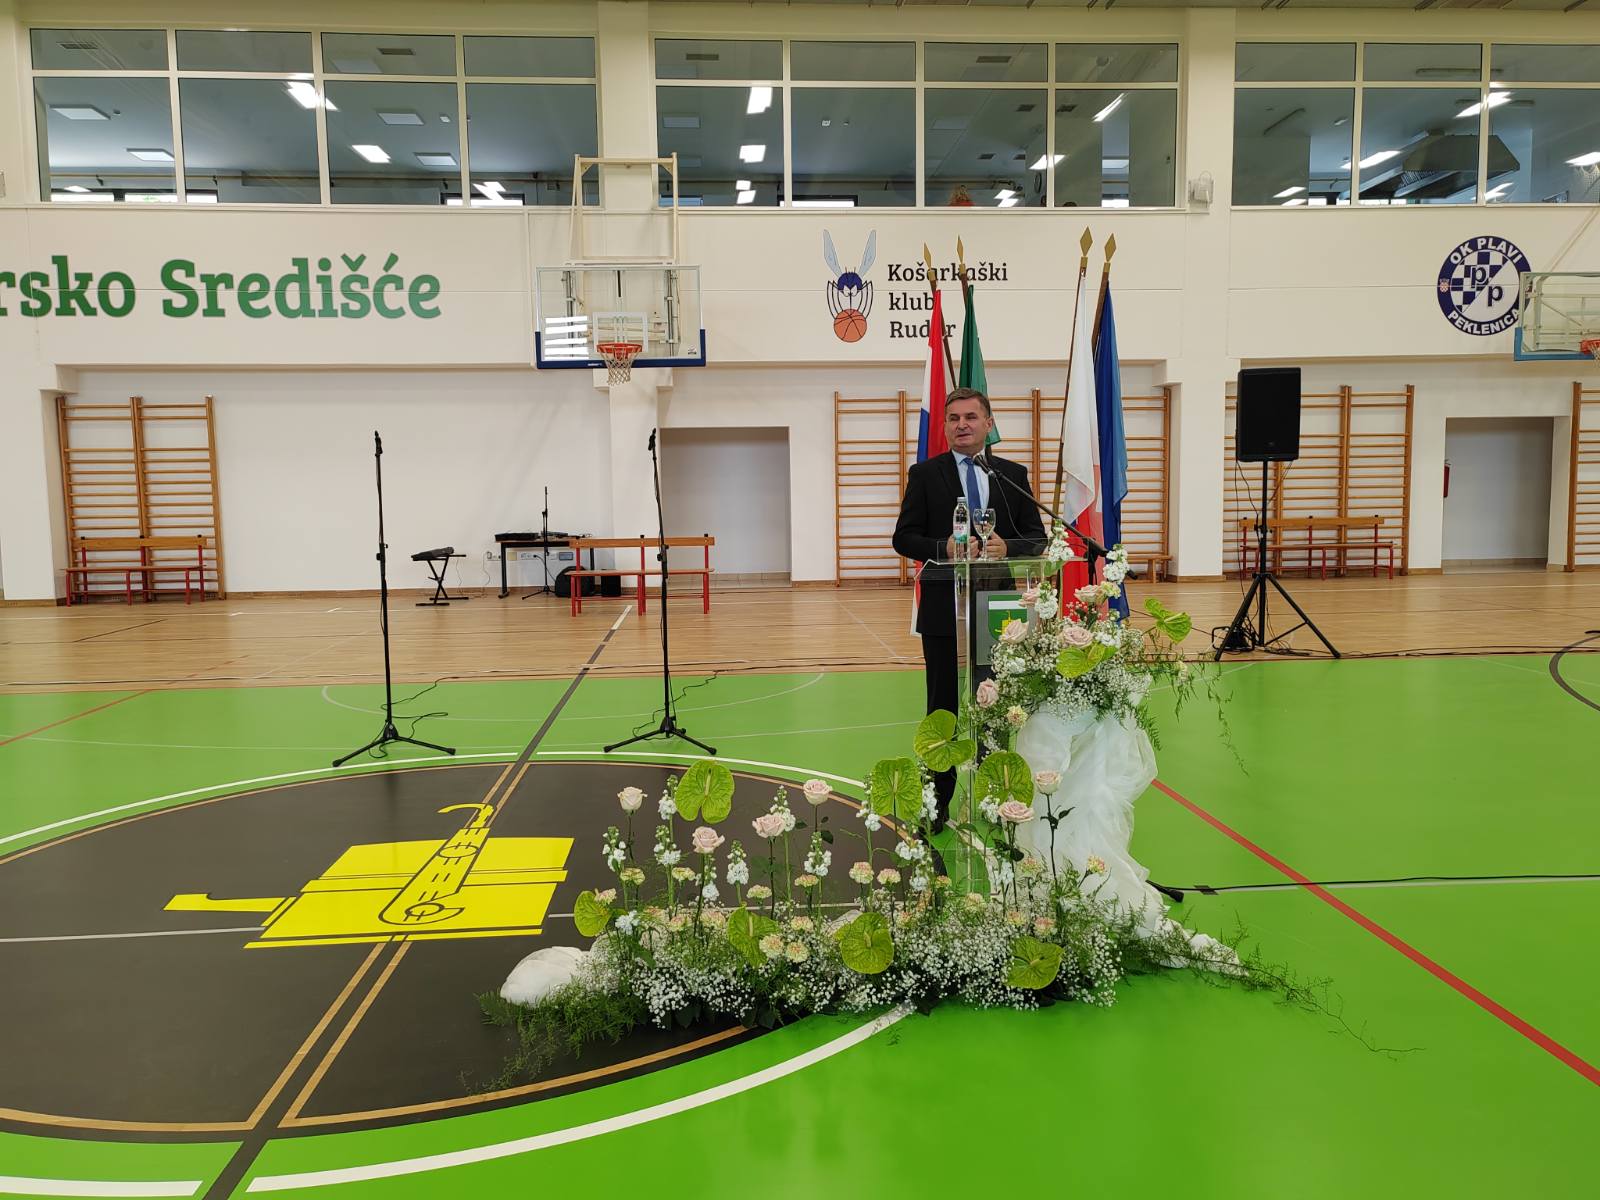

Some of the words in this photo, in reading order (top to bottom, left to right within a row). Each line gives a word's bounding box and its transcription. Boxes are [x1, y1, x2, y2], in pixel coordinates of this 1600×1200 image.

[1450, 241, 1474, 264] OK
[1477, 237, 1522, 264] PLAVI
[160, 252, 442, 319] Središće
[888, 292, 936, 311] klub
[889, 319, 956, 338] Rudr
[1447, 308, 1520, 335] PEKLENICA
